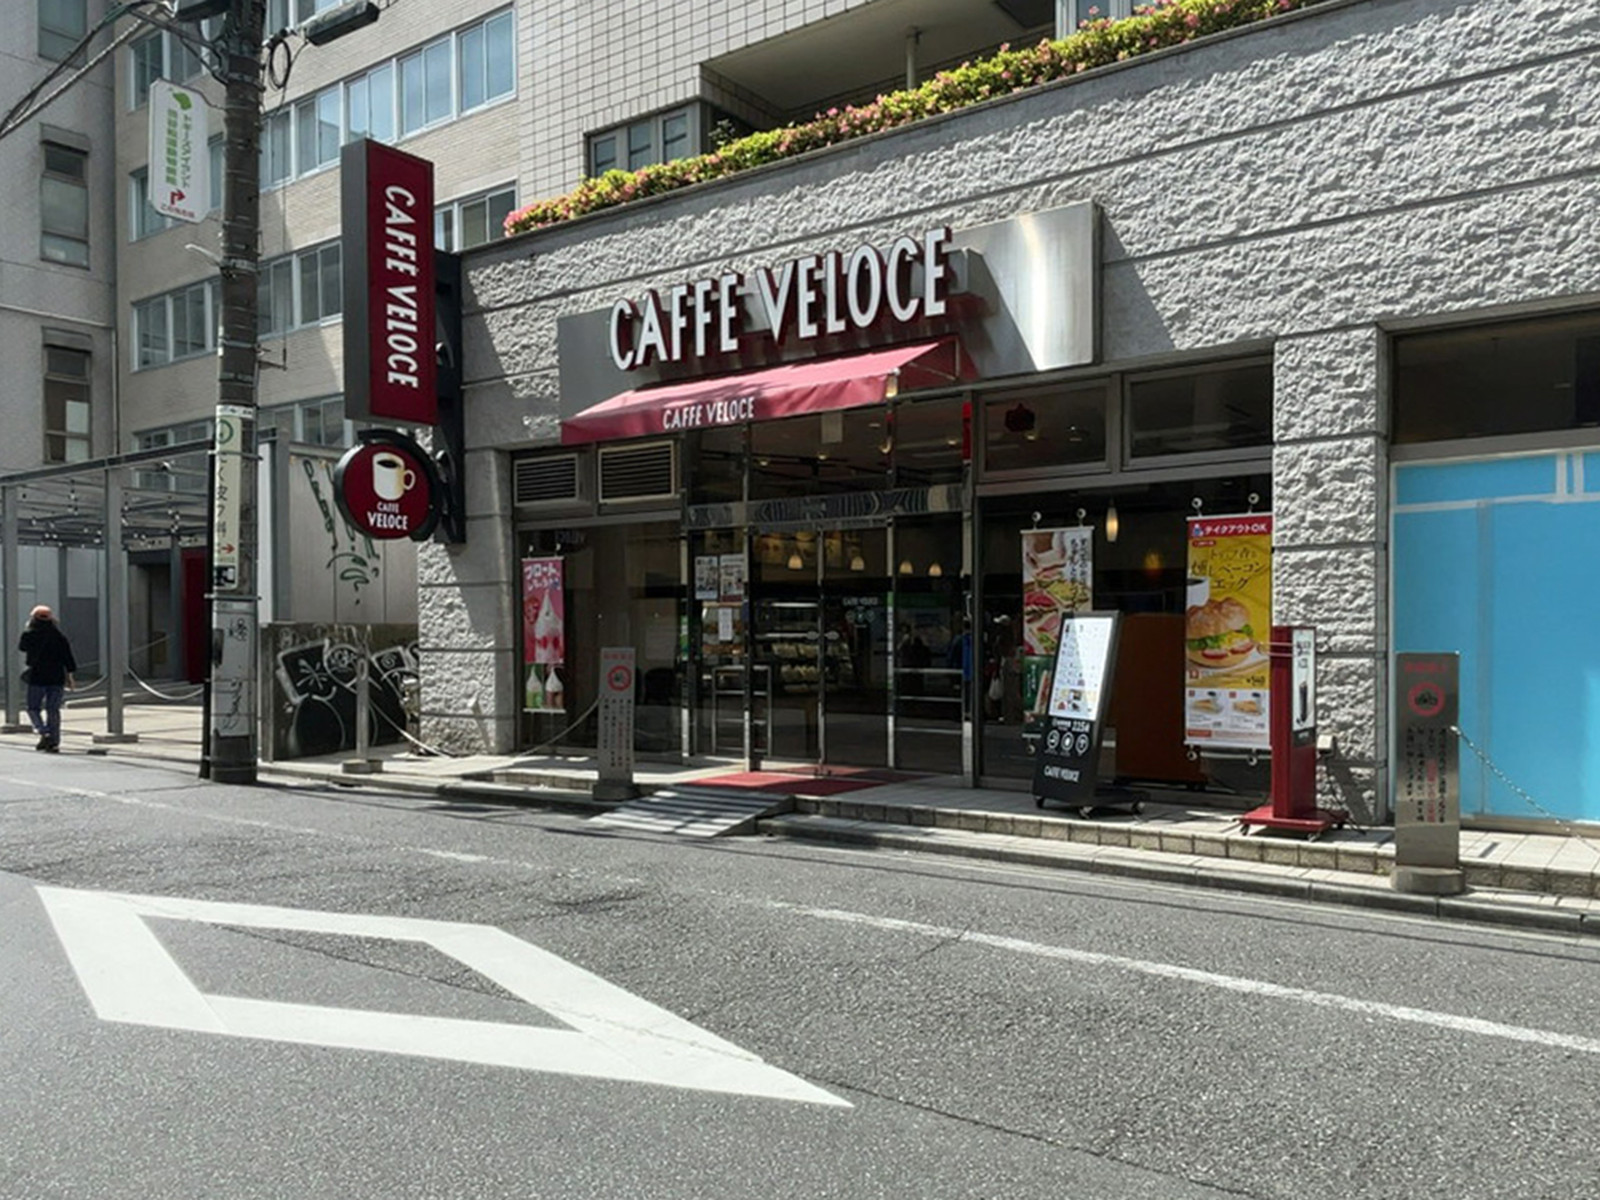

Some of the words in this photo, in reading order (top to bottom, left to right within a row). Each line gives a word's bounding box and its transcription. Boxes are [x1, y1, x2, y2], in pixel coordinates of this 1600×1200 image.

[756, 227, 949, 342] VELOCE
[386, 285, 418, 388] VELOCE
[662, 404, 703, 430] CAFFE
[706, 397, 755, 423] VELOCE
[366, 510, 409, 531] VELOCE
